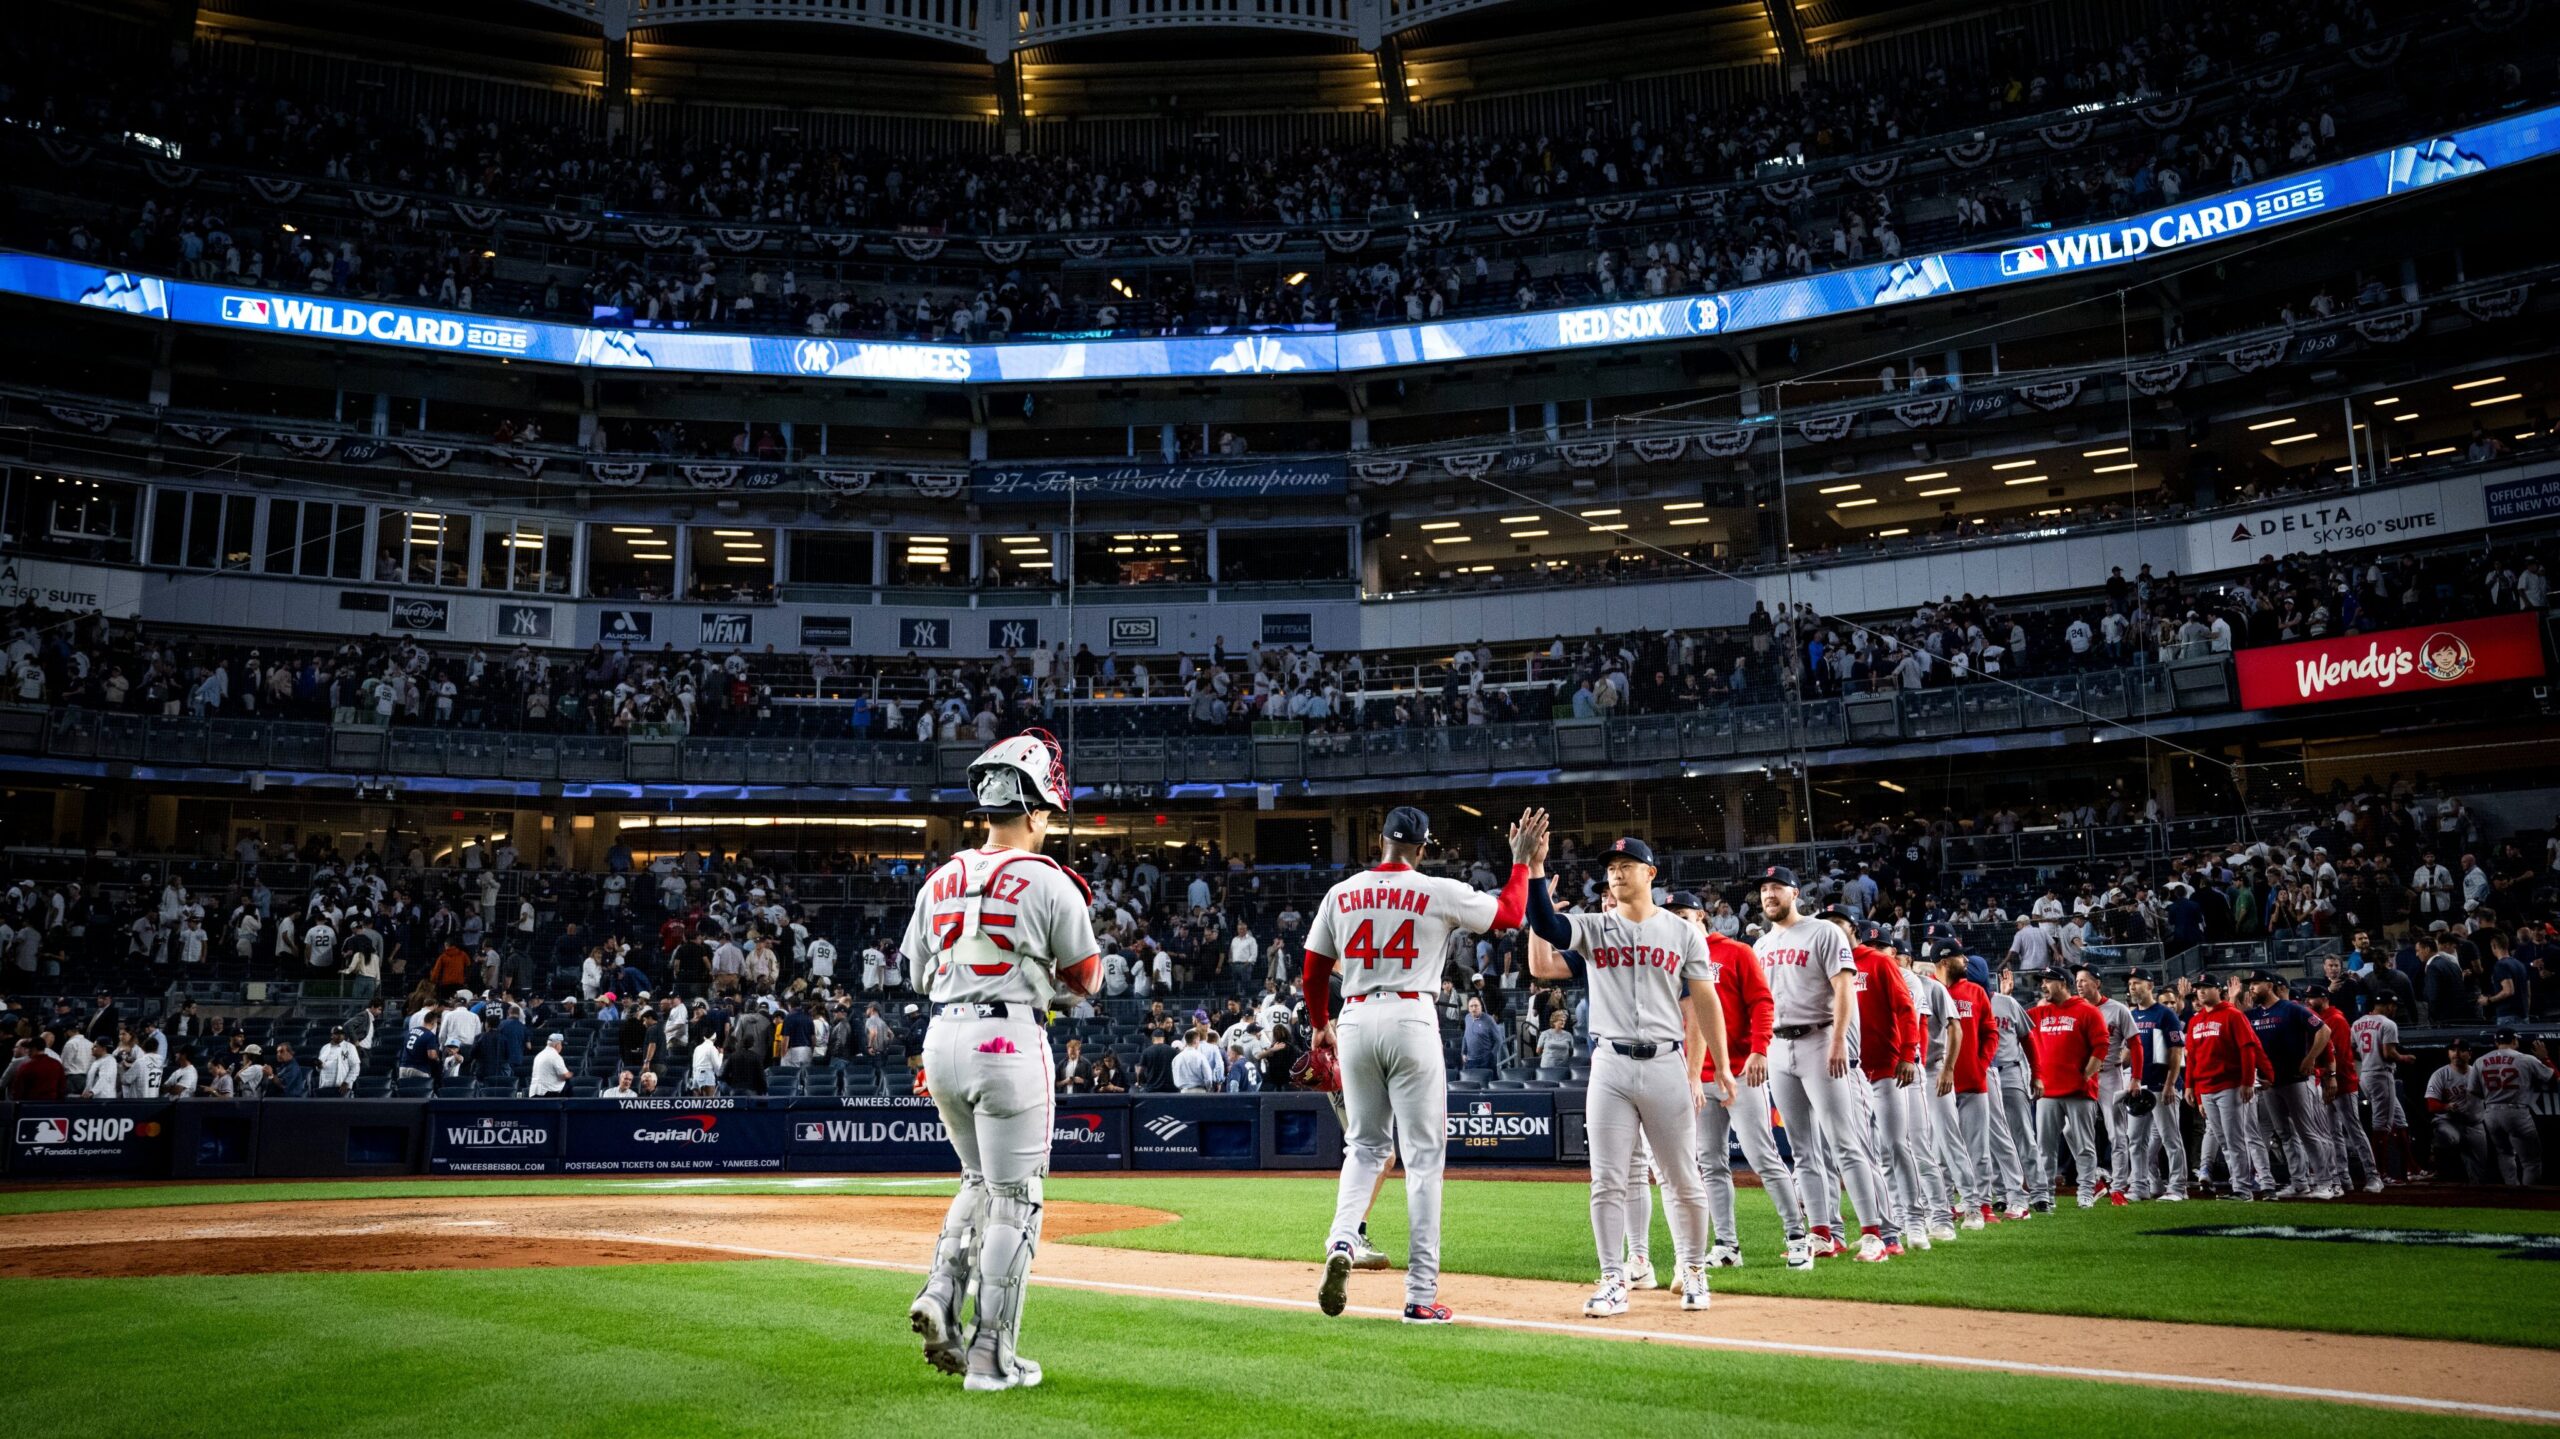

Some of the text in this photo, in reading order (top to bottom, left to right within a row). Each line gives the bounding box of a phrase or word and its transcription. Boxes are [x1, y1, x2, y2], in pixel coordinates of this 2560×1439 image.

[2255, 186, 2325, 217] 2025
[1559, 304, 1664, 345] RED SOX
[467, 331, 527, 348] 2025
[2299, 334, 2338, 355] 1958
[858, 345, 971, 380] YANKEES
[1968, 396, 2003, 413] 1956
[344, 445, 377, 458] 1951
[745, 472, 779, 486] 1952
[1106, 468, 1187, 491] World
[1196, 468, 1332, 495] Champions
[2490, 484, 2539, 502] OFFICIAL
[2491, 502, 2514, 516] THE
[2515, 499, 2541, 513] NEW
[2261, 506, 2352, 536] DELTA
[2384, 512, 2437, 533] SUITE
[48, 589, 97, 606] SUITE
[395, 605, 445, 621] Hard Rock
[605, 631, 647, 641] Audacy
[703, 622, 747, 644] WFAN
[1118, 623, 1150, 635] YES
[2071, 629, 2083, 639] 24
[2296, 642, 2413, 697] Wendy's
[1338, 887, 1430, 916] CHAPMAN
[315, 935, 329, 946] 22
[1344, 918, 1420, 970] 44
[817, 947, 831, 959] 99
[863, 953, 876, 966] 42
[1592, 945, 1681, 975] BOSTON
[1272, 1011, 1289, 1024] 99
[2354, 1021, 2382, 1032] RAFAELA
[407, 1035, 417, 1050] 2
[2360, 1032, 2373, 1053] 3
[618, 1098, 735, 1110] YANKEES.COM/2026
[72, 1117, 135, 1143] SHOP
[494, 1119, 520, 1128] 2025
[1133, 1145, 1198, 1154] BANK OF AMERICA
[1465, 1137, 1498, 1147] 2025
[24, 1146, 122, 1156] A Fanatics Experience
[449, 1163, 546, 1172] YANKEESBEISBOL.COM
[565, 1161, 619, 1171] POSTSEASON
[620, 1161, 650, 1170] TICKETS
[652, 1160, 664, 1169] ON
[665, 1160, 690, 1169] SALE
[691, 1160, 713, 1169] NOW
[722, 1159, 780, 1169] YANKEES.COM
